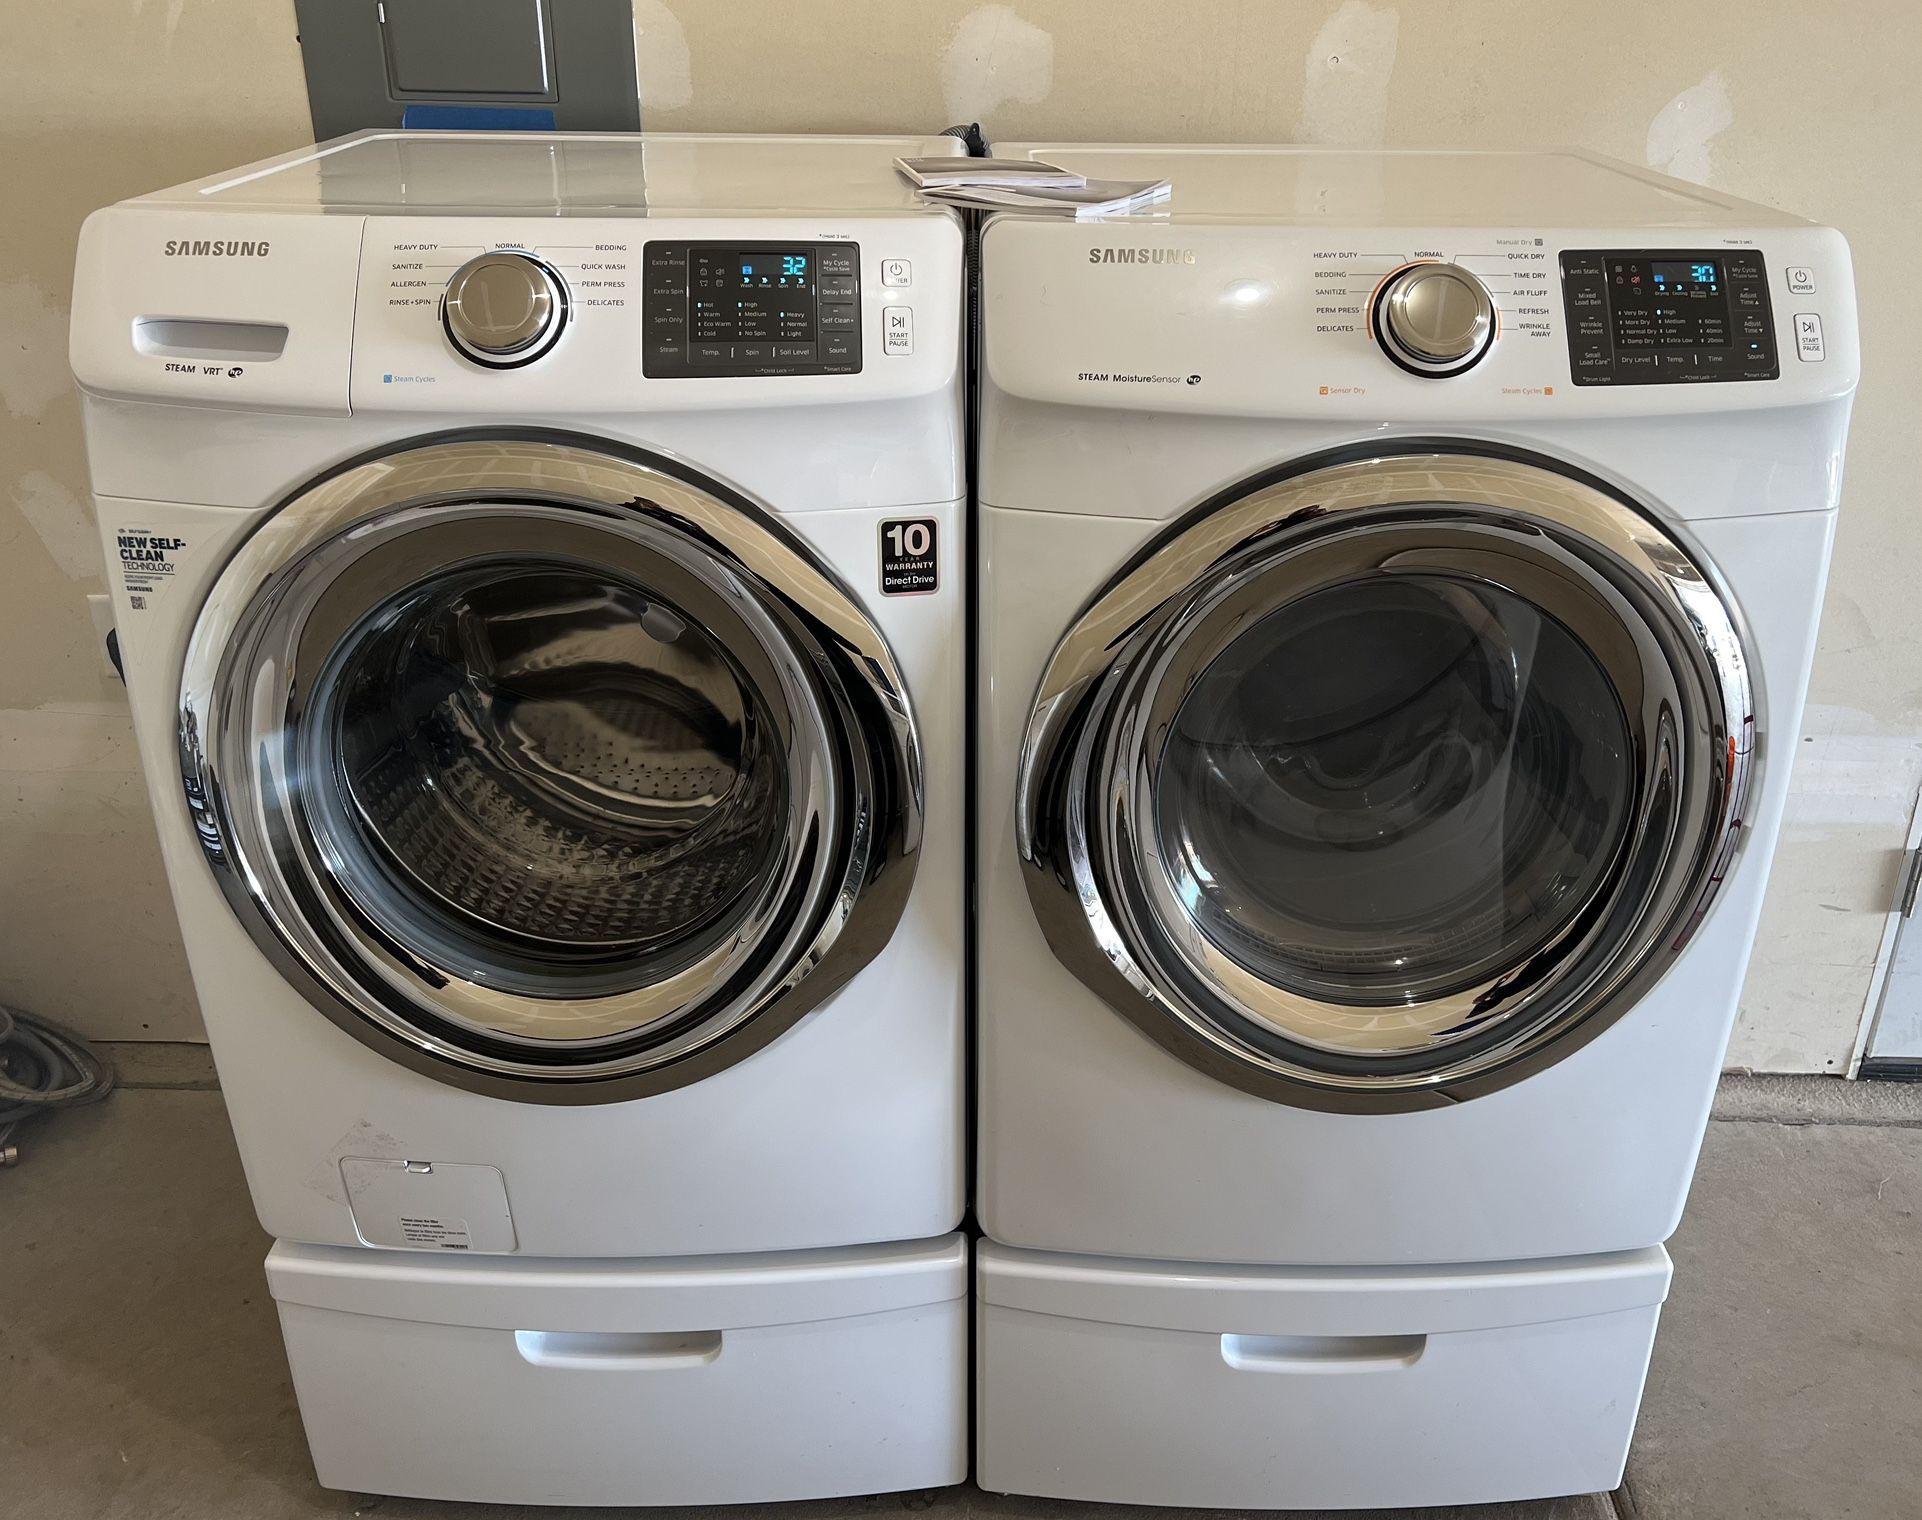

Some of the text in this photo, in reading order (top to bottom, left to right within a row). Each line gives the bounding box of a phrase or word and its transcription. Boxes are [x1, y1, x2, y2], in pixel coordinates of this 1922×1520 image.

[164, 240, 270, 257] SAMSUNG
[1517, 239, 1533, 247] Dry
[1089, 248, 1196, 265] SAMSUNG
[1507, 252, 1529, 260] QUICK
[580, 263, 603, 271] QUICK
[782, 256, 806, 275] 32
[1691, 265, 1714, 282] 30
[164, 363, 196, 374] STEAM
[393, 375, 436, 383] Steam Cycles
[1078, 373, 1109, 381] STEAM
[1112, 374, 1181, 384] MoistureSensor
[1350, 387, 1366, 395] Dry
[1522, 387, 1543, 395] Cycles
[117, 535, 187, 550] NEW SELF-
[886, 523, 931, 557] 10
[119, 548, 165, 562] CLEAN
[121, 560, 175, 572] TECHNOLOGY
[885, 561, 934, 571] WARRANTY
[885, 575, 935, 586] Direct Drive
